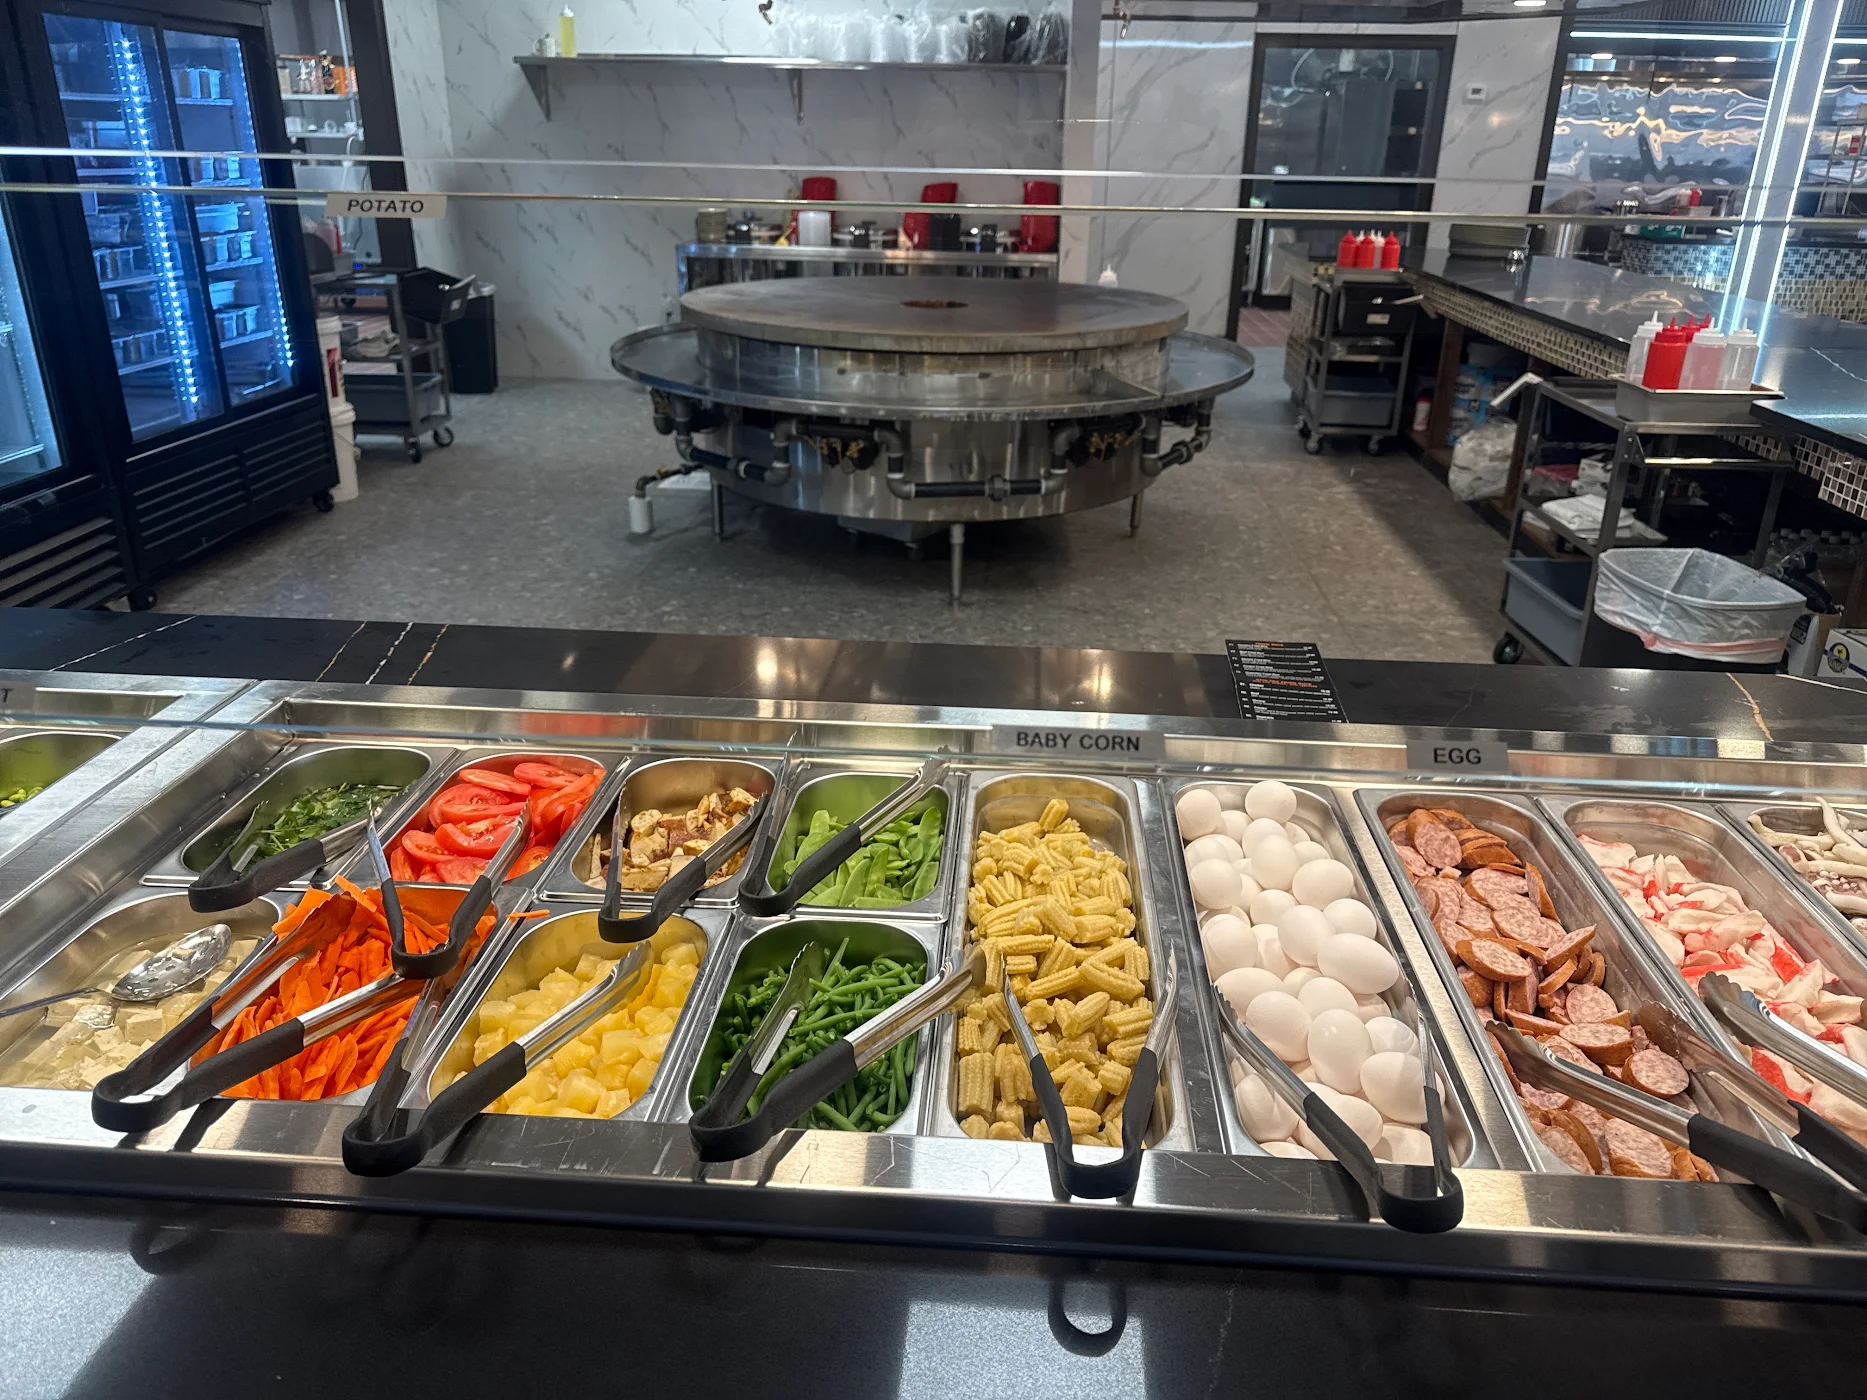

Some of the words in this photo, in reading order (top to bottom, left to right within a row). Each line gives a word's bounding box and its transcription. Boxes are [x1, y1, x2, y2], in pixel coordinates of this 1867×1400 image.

[347, 199, 424, 213] POTATO
[1016, 731, 1072, 748] BABY
[1079, 734, 1140, 752] CORN
[1433, 747, 1482, 765] EGG
